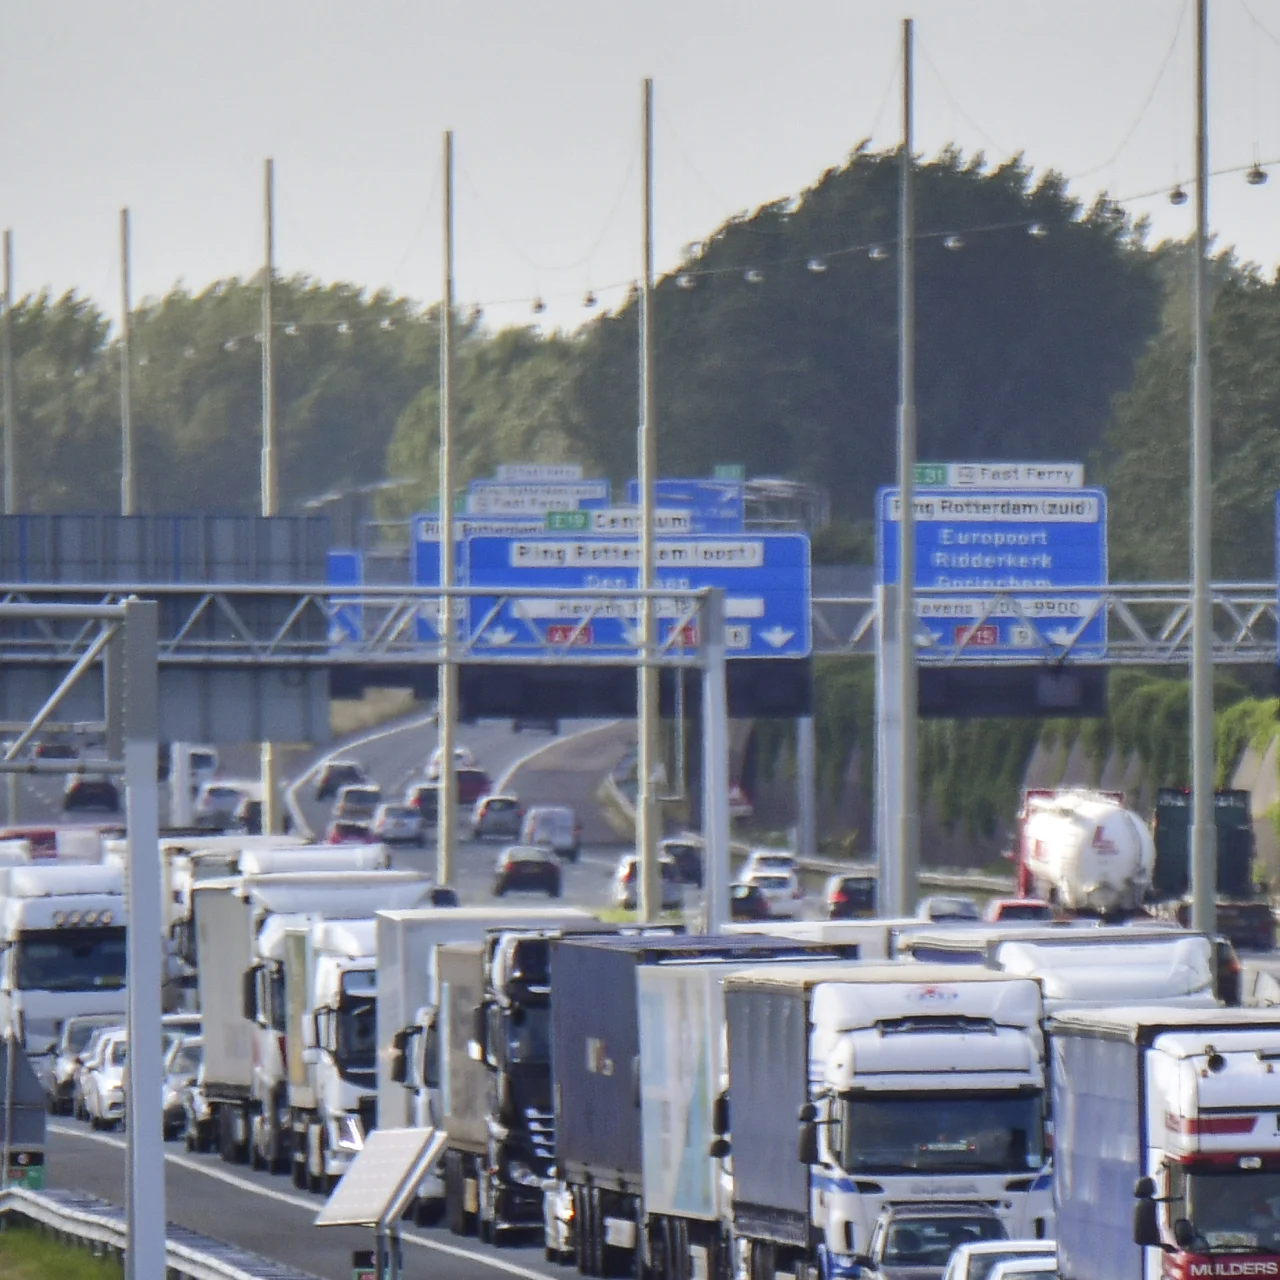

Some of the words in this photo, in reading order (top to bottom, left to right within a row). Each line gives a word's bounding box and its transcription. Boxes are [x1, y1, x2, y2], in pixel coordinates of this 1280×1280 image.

[980, 467, 1020, 481] Fast
[1025, 467, 1075, 484] Ferry
[940, 500, 1039, 515] Rotterdam
[1041, 500, 1093, 516] (zuid)
[596, 513, 688, 527] Cenum
[939, 528, 1049, 547] Europoort
[934, 552, 1052, 569] Ridderkerk
[922, 601, 974, 615] avens
[1190, 1261, 1279, 1277] MULDERS
